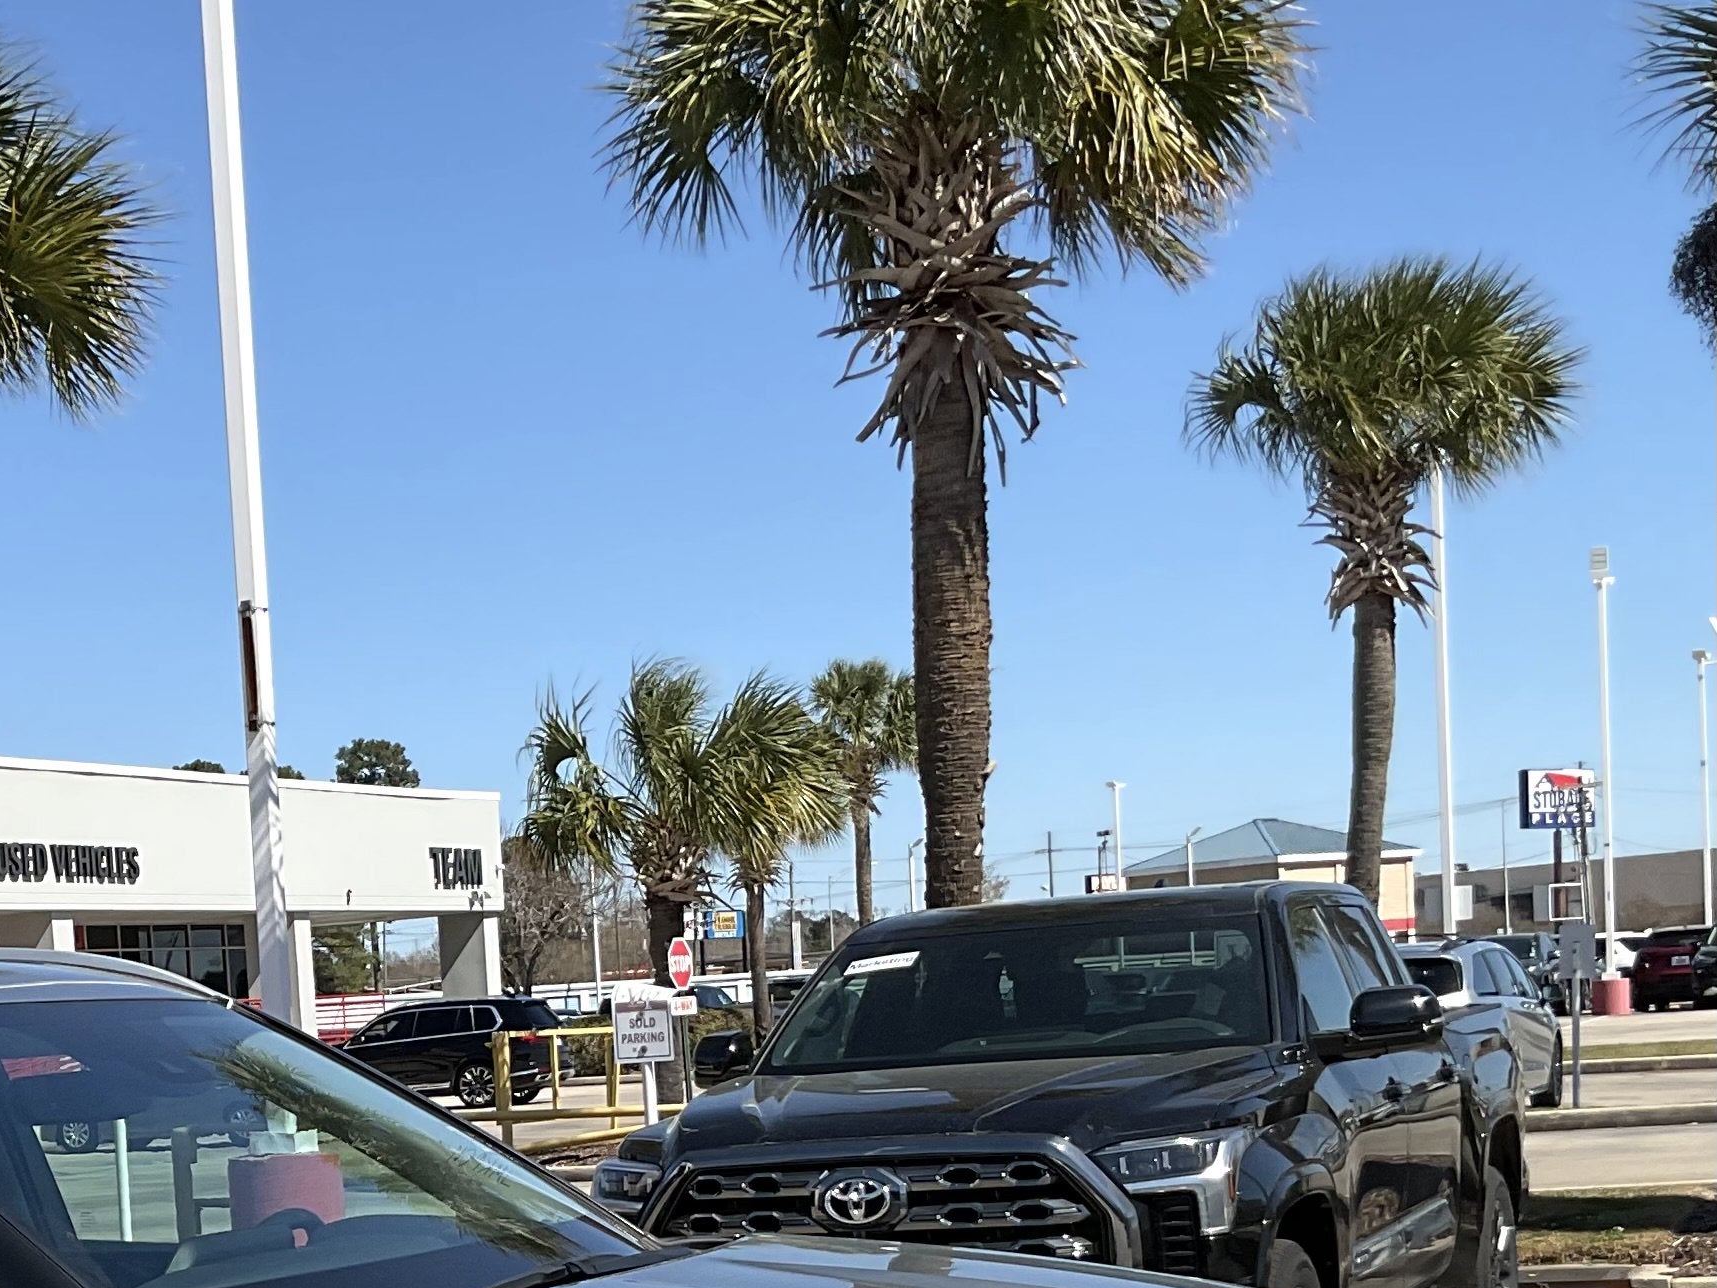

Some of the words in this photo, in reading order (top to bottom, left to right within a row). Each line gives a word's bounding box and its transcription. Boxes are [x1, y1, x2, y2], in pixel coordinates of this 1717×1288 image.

[1531, 812, 1593, 824] PLACE
[49, 844, 140, 884] VEHICLES
[429, 847, 483, 888] TEAM
[670, 955, 691, 972] STOP
[629, 1017, 656, 1029] SOLD
[621, 1031, 665, 1044] PARKING
